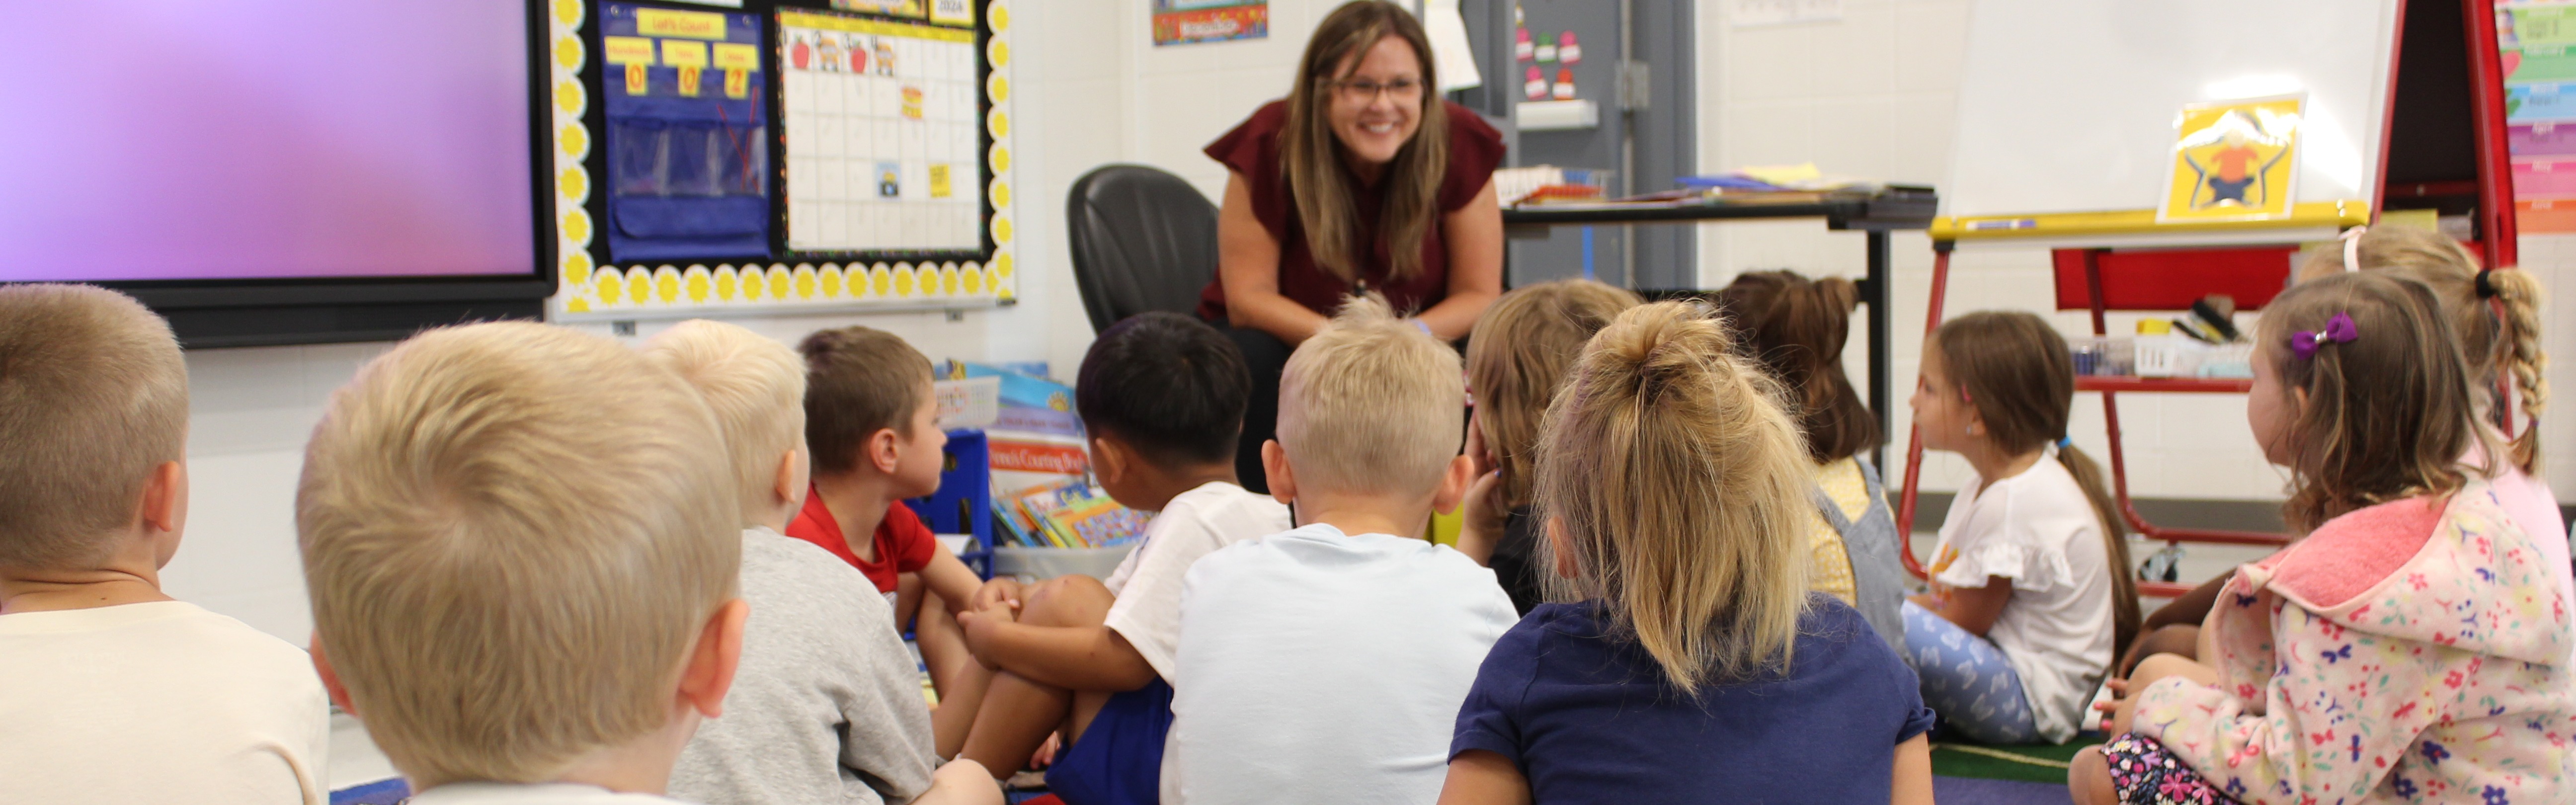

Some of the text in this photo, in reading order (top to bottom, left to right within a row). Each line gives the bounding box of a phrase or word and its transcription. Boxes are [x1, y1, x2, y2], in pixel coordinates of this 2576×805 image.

[938, 0, 963, 13] 2024
[652, 16, 711, 33] Let's Count
[629, 64, 643, 89] 0
[683, 66, 696, 91] 0
[730, 68, 743, 93] 2
